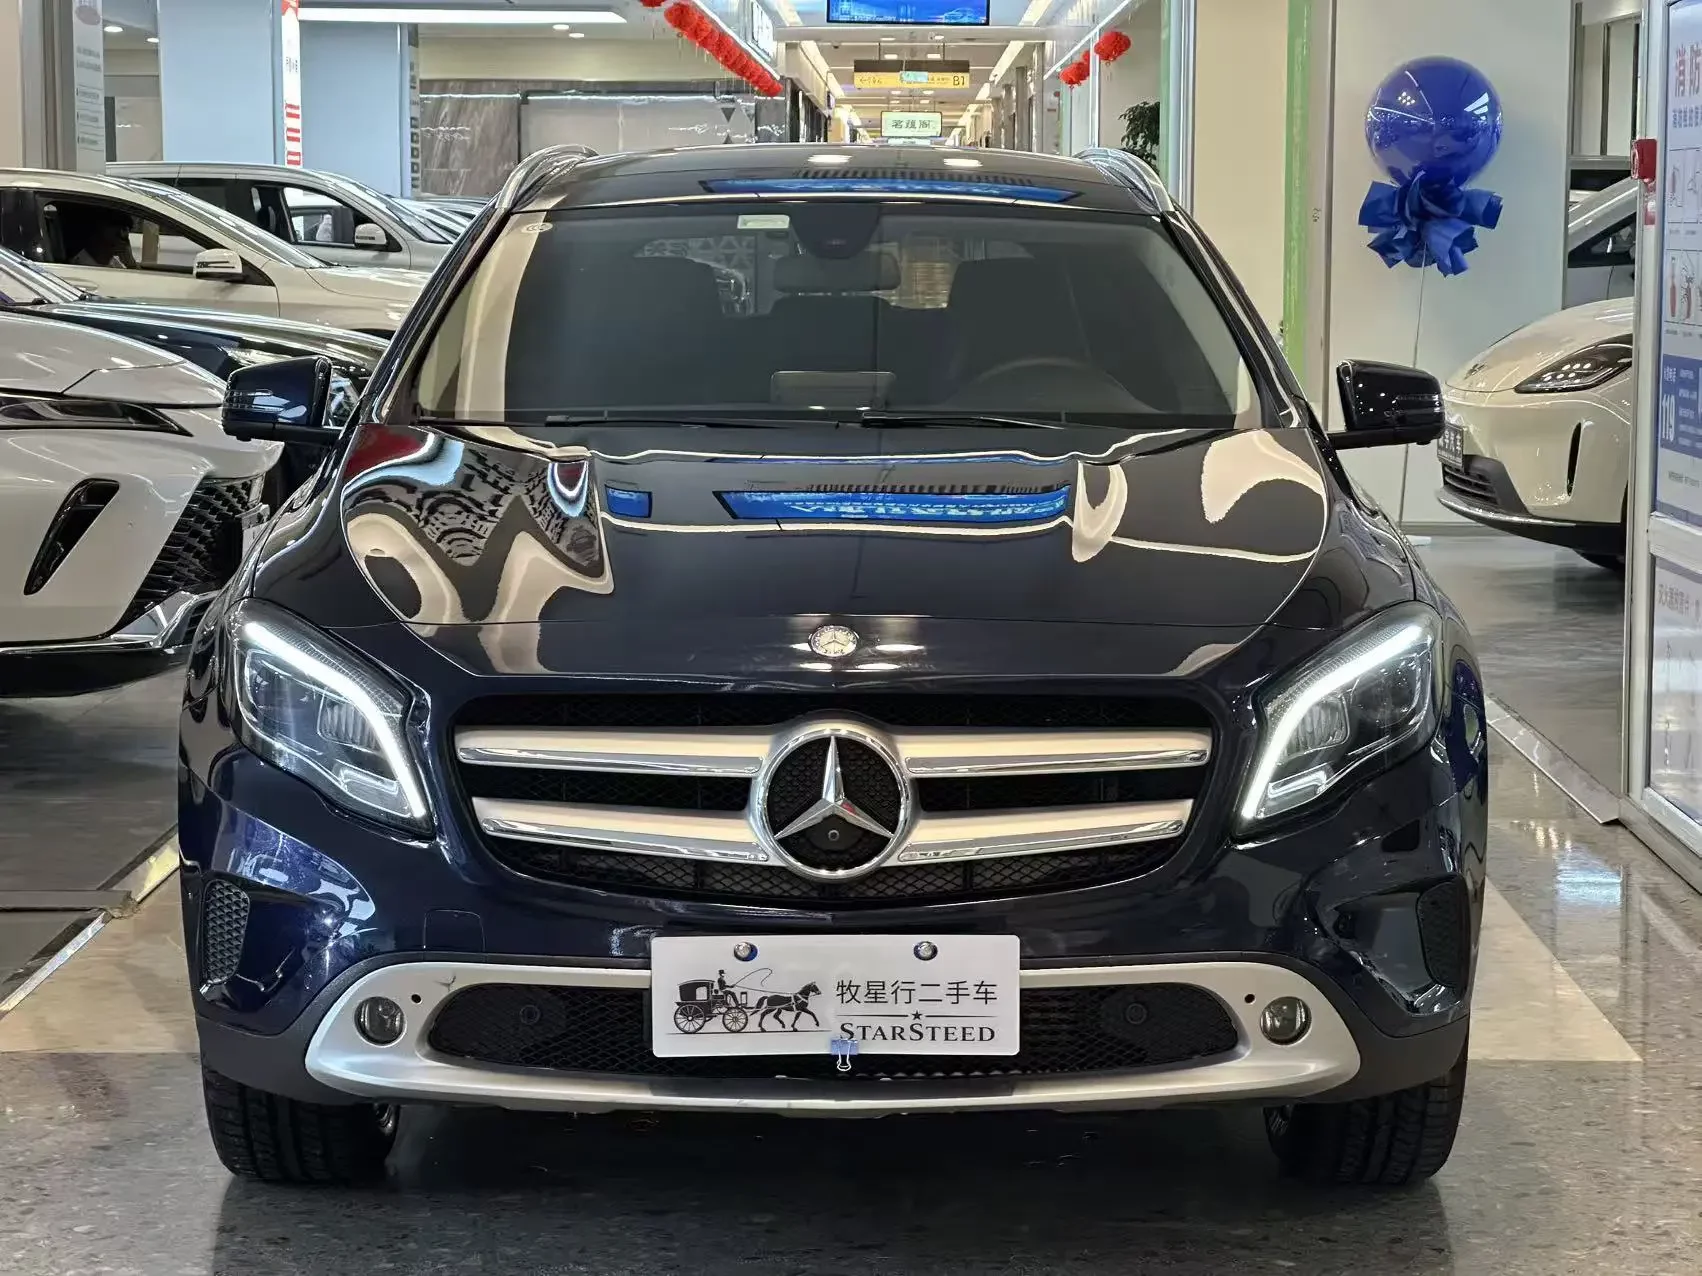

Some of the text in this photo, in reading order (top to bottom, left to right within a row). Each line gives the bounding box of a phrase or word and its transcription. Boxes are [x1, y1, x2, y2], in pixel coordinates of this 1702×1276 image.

[1662, 394, 1676, 442] 119
[836, 979, 998, 1004] 牧星行二手车
